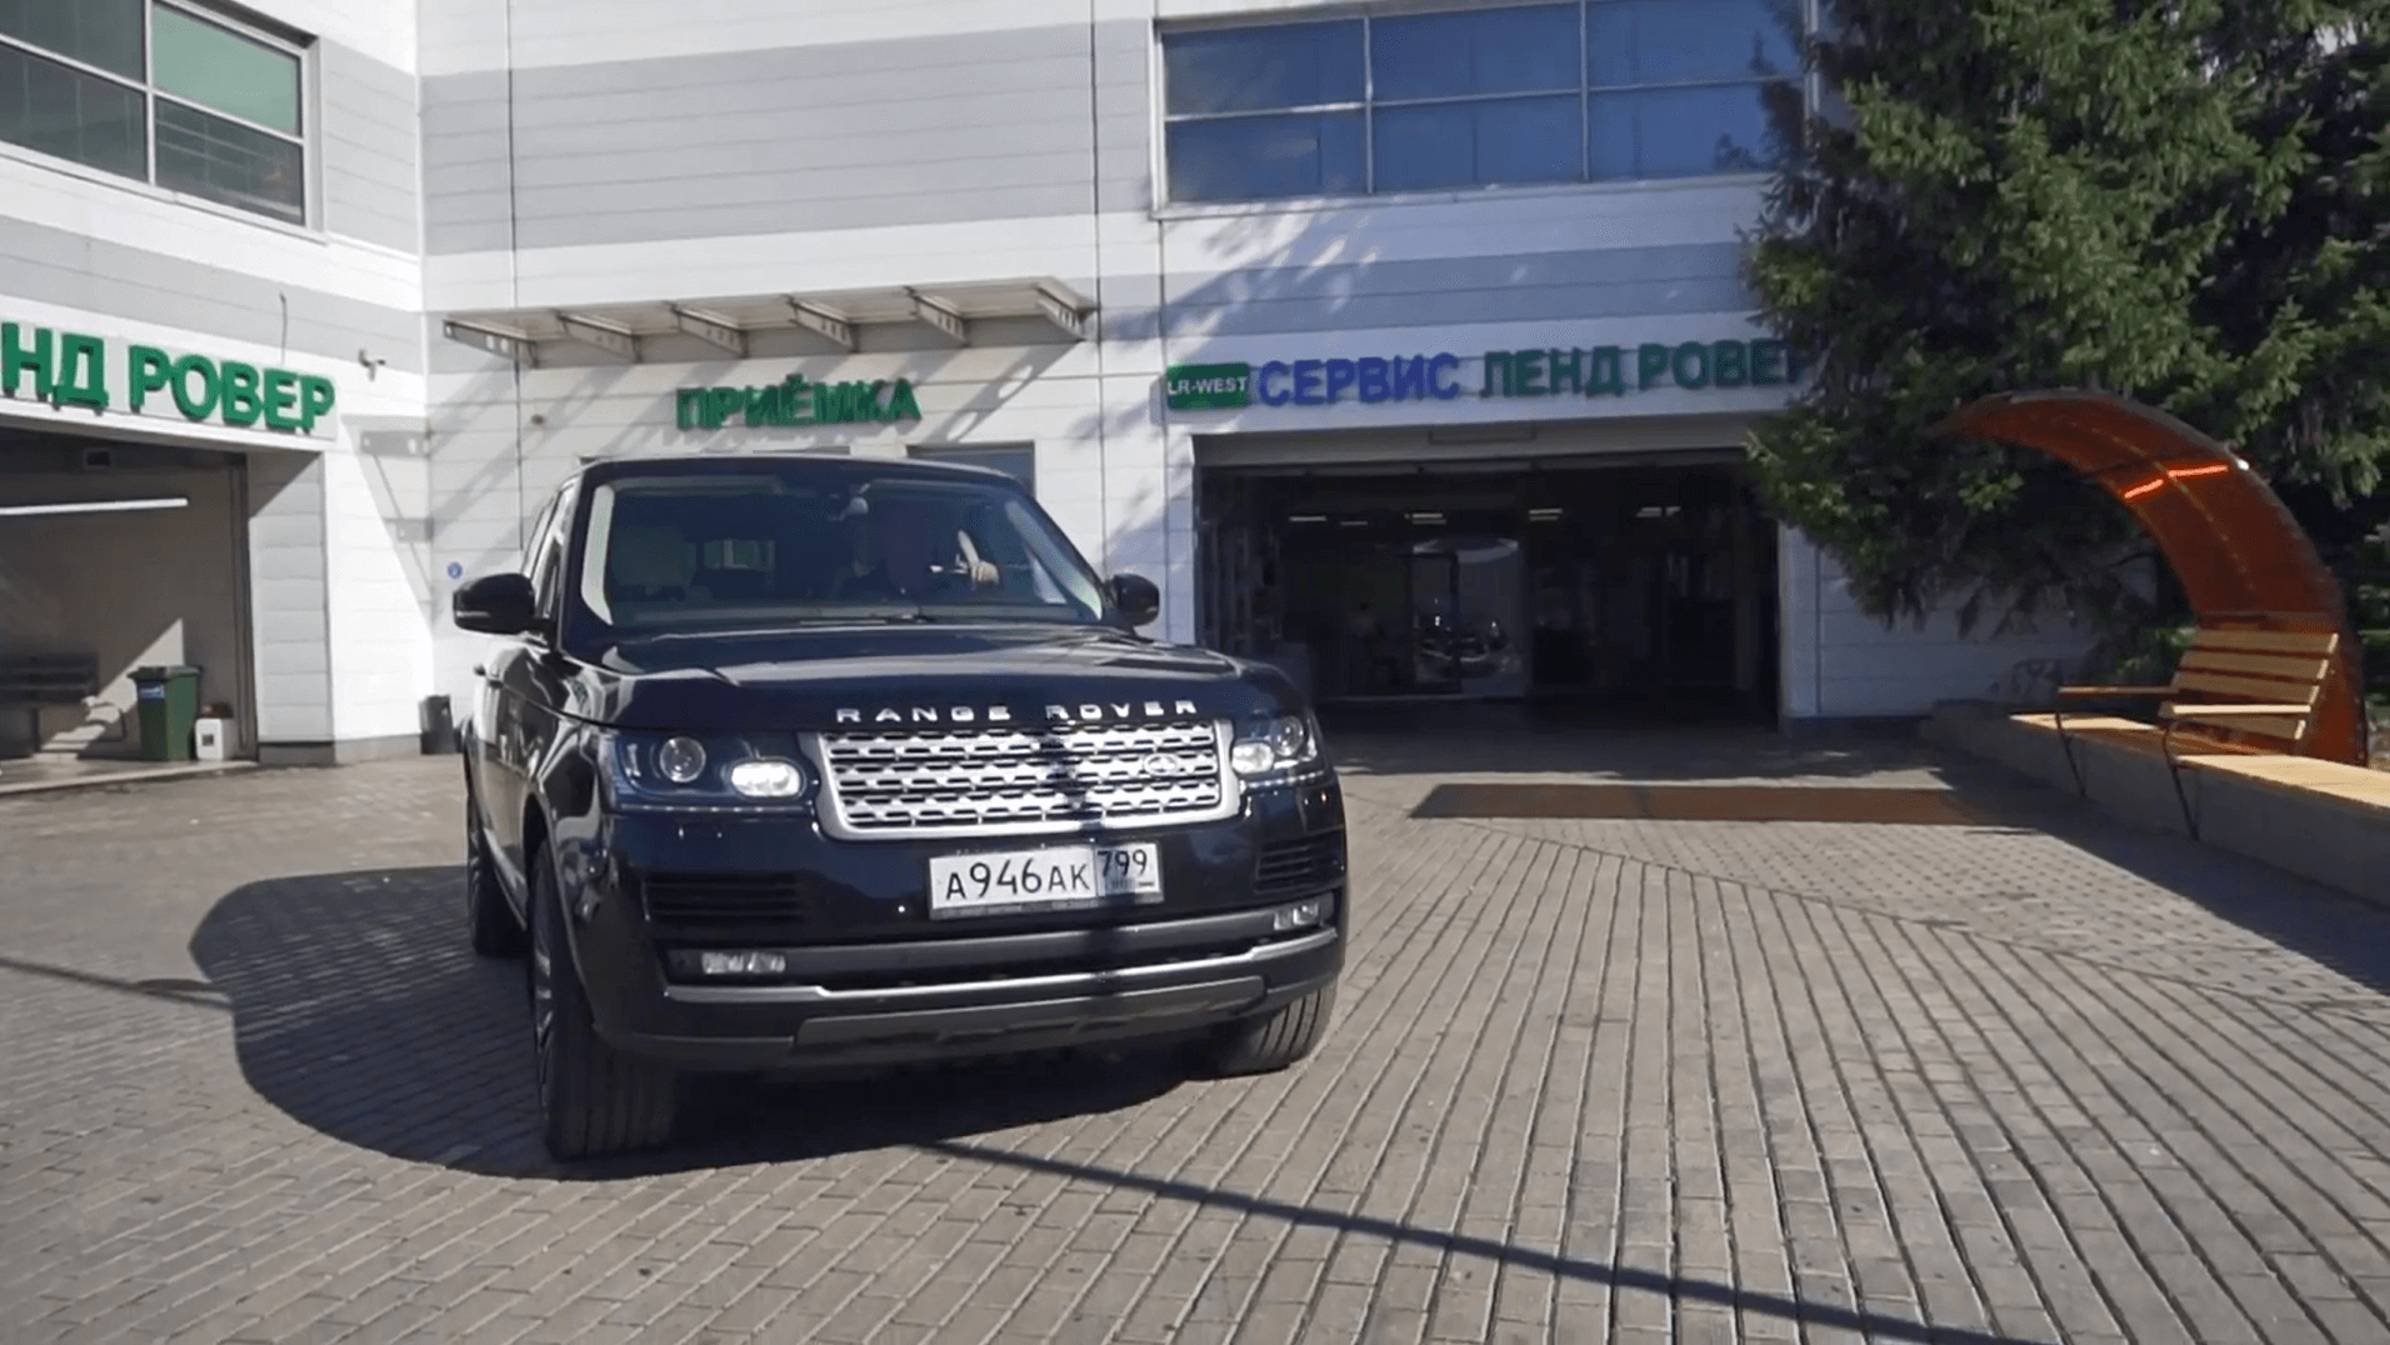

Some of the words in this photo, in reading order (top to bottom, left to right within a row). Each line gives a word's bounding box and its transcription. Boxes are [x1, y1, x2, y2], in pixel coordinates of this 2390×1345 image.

[1, 321, 109, 415] НД
[128, 344, 336, 436] РОВЕР
[1167, 376, 1249, 396] LR-WEST
[1259, 352, 1460, 407] СЕРВИС
[1480, 346, 1626, 398] ЛЕНД
[836, 706, 1010, 723] RANGE
[1045, 700, 1196, 722] ROVER
[1097, 849, 1148, 878] 799
